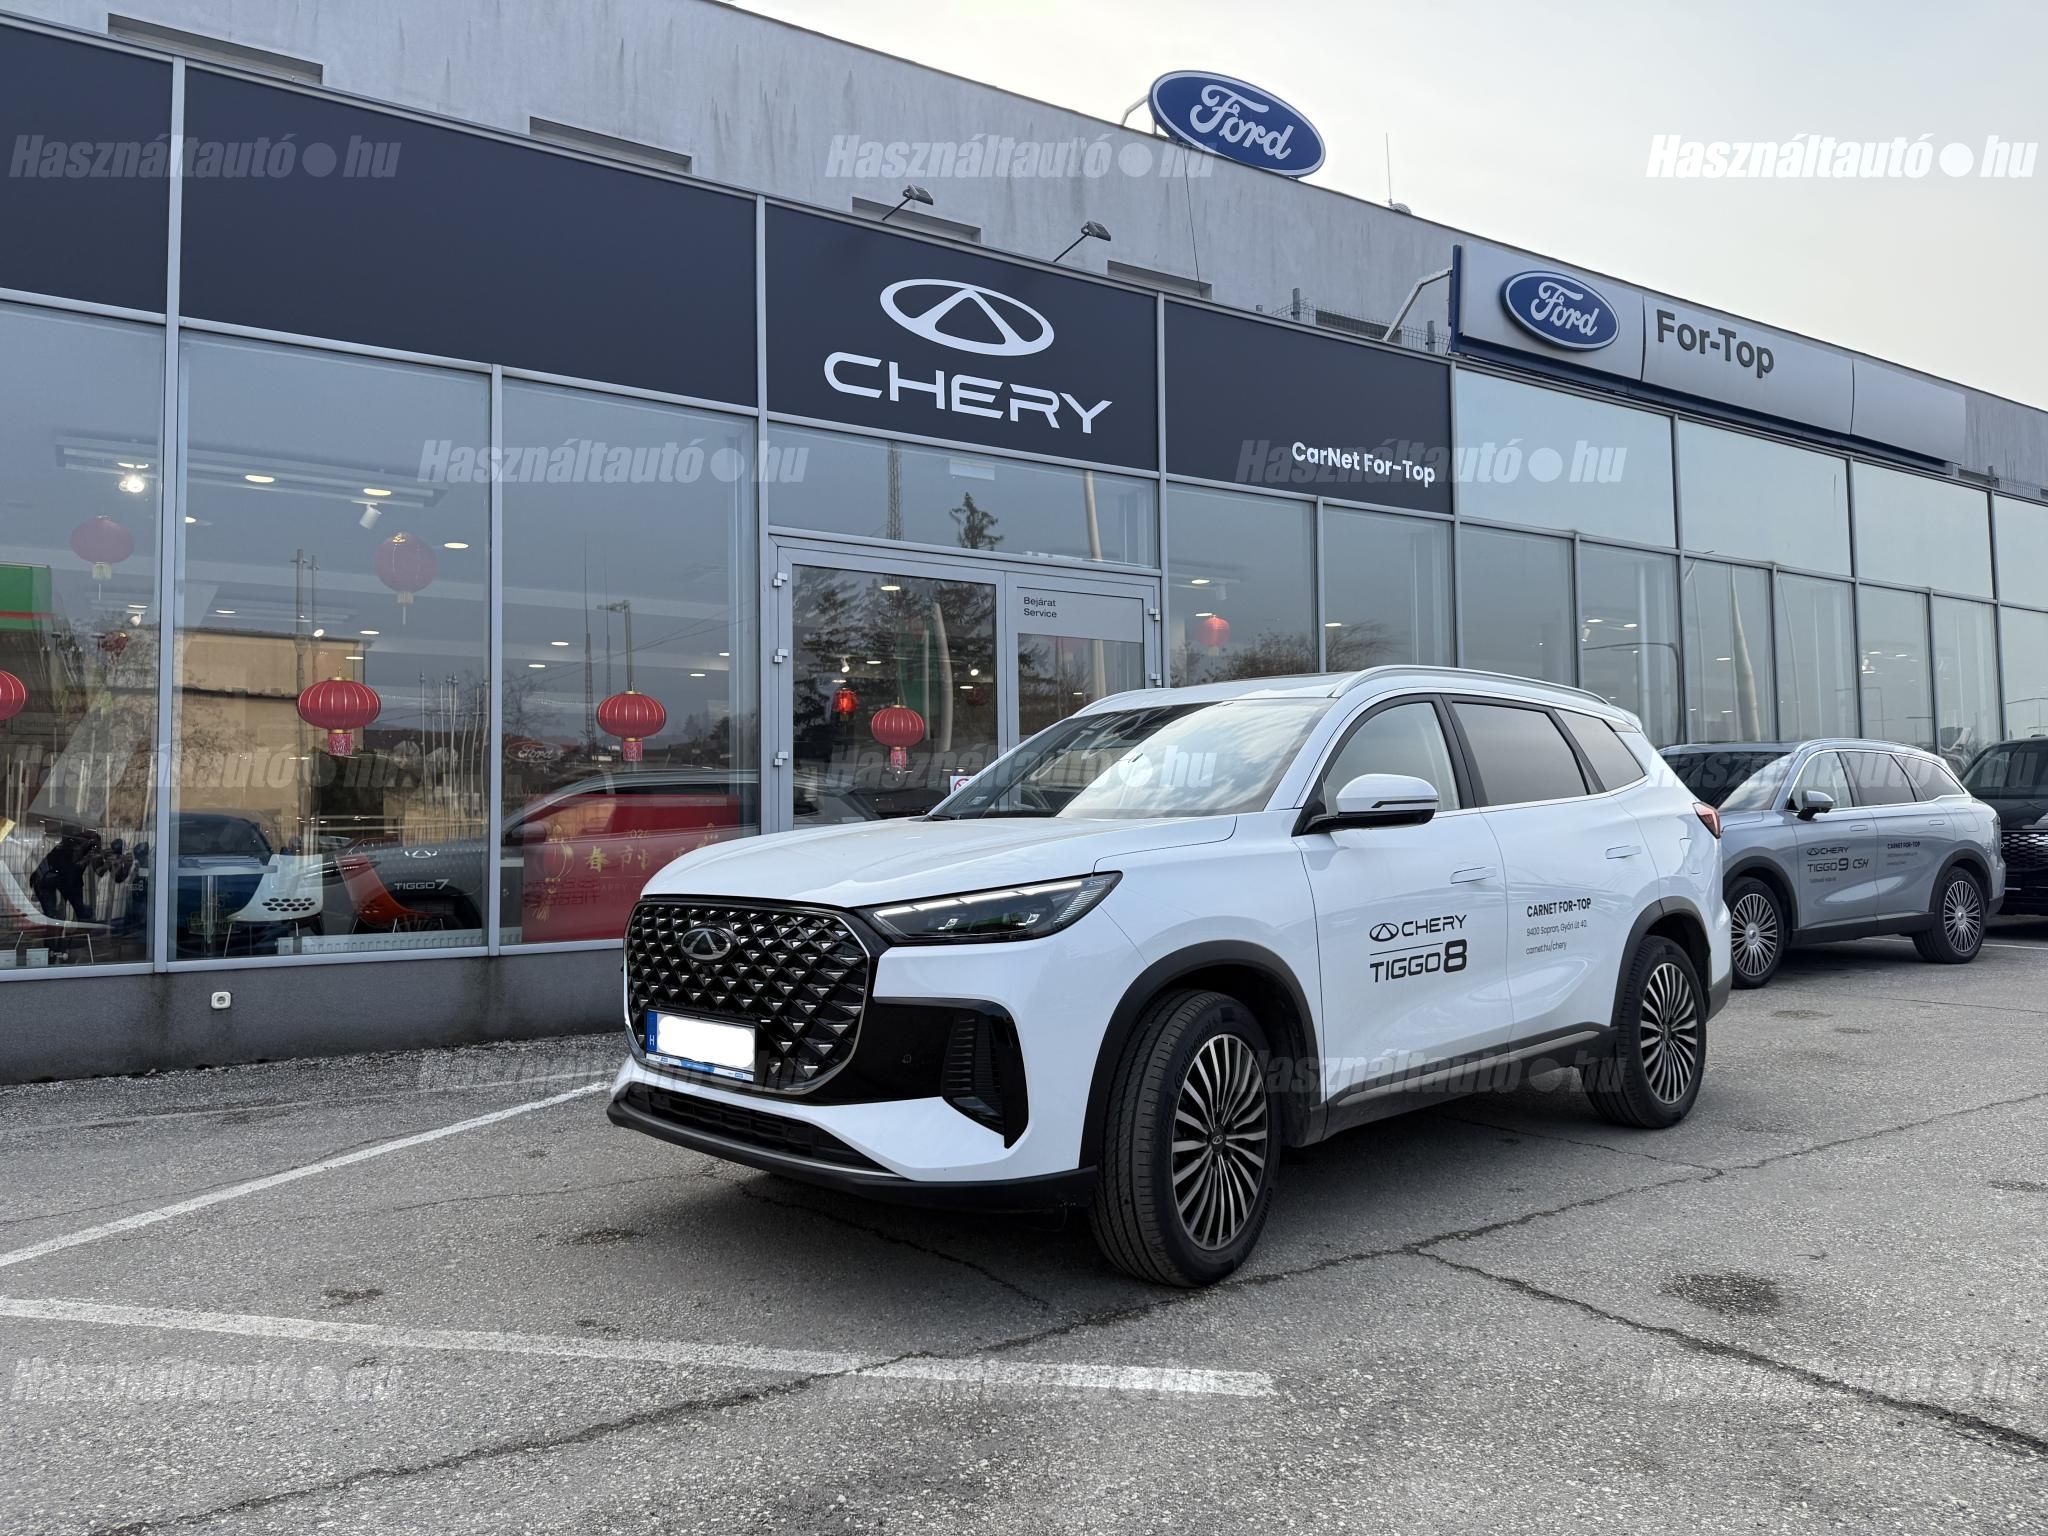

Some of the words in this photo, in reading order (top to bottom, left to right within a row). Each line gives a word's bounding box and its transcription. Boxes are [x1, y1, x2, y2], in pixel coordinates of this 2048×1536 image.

[1189, 84, 1295, 160] Ford
[1530, 281, 1600, 337] Ford
[1656, 308, 1774, 379] For-Top
[823, 351, 1113, 434] CHERY
[1291, 441, 1360, 471] CarNet
[1364, 453, 1436, 488] For-Top
[1023, 596, 1057, 608] Bejárat
[1023, 607, 1057, 618] Service
[1820, 846, 1850, 855] CHERY
[1526, 902, 1558, 918] CARNET
[1558, 897, 1592, 914] FOR-TOP
[1401, 914, 1467, 937] CHERY
[1526, 926, 1540, 937] 9400
[649, 1034, 655, 1046] H
